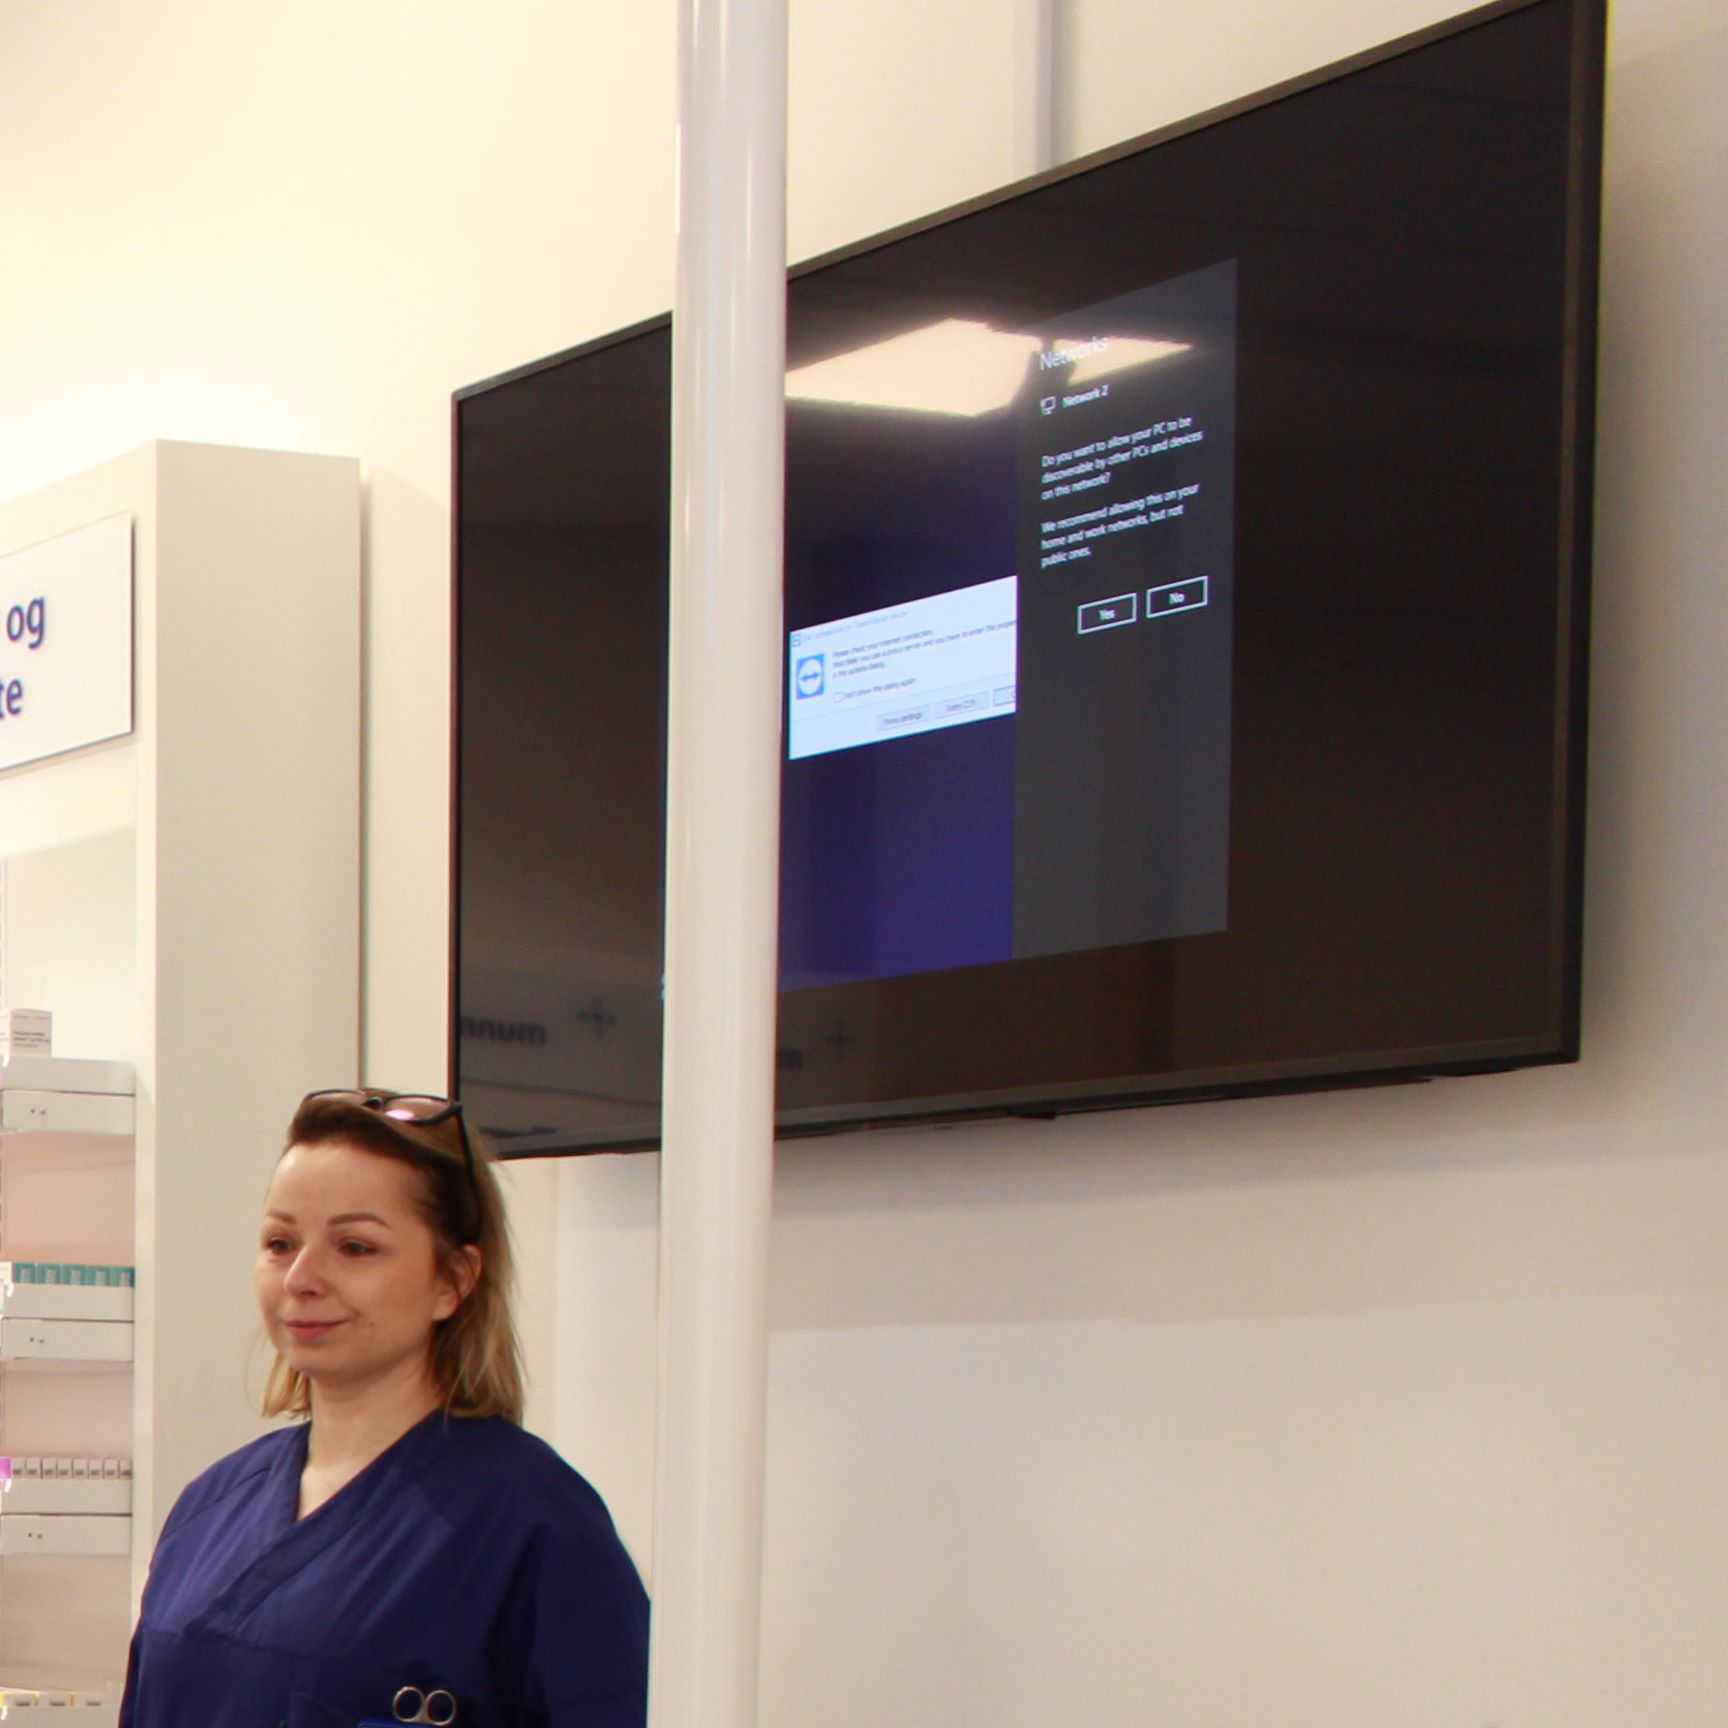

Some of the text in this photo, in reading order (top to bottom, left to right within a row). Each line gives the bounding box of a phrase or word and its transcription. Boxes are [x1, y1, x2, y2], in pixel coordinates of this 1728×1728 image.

[1040, 336, 1108, 370] Networks
[1062, 384, 1109, 408] Network 2
[6, 595, 46, 654] og
